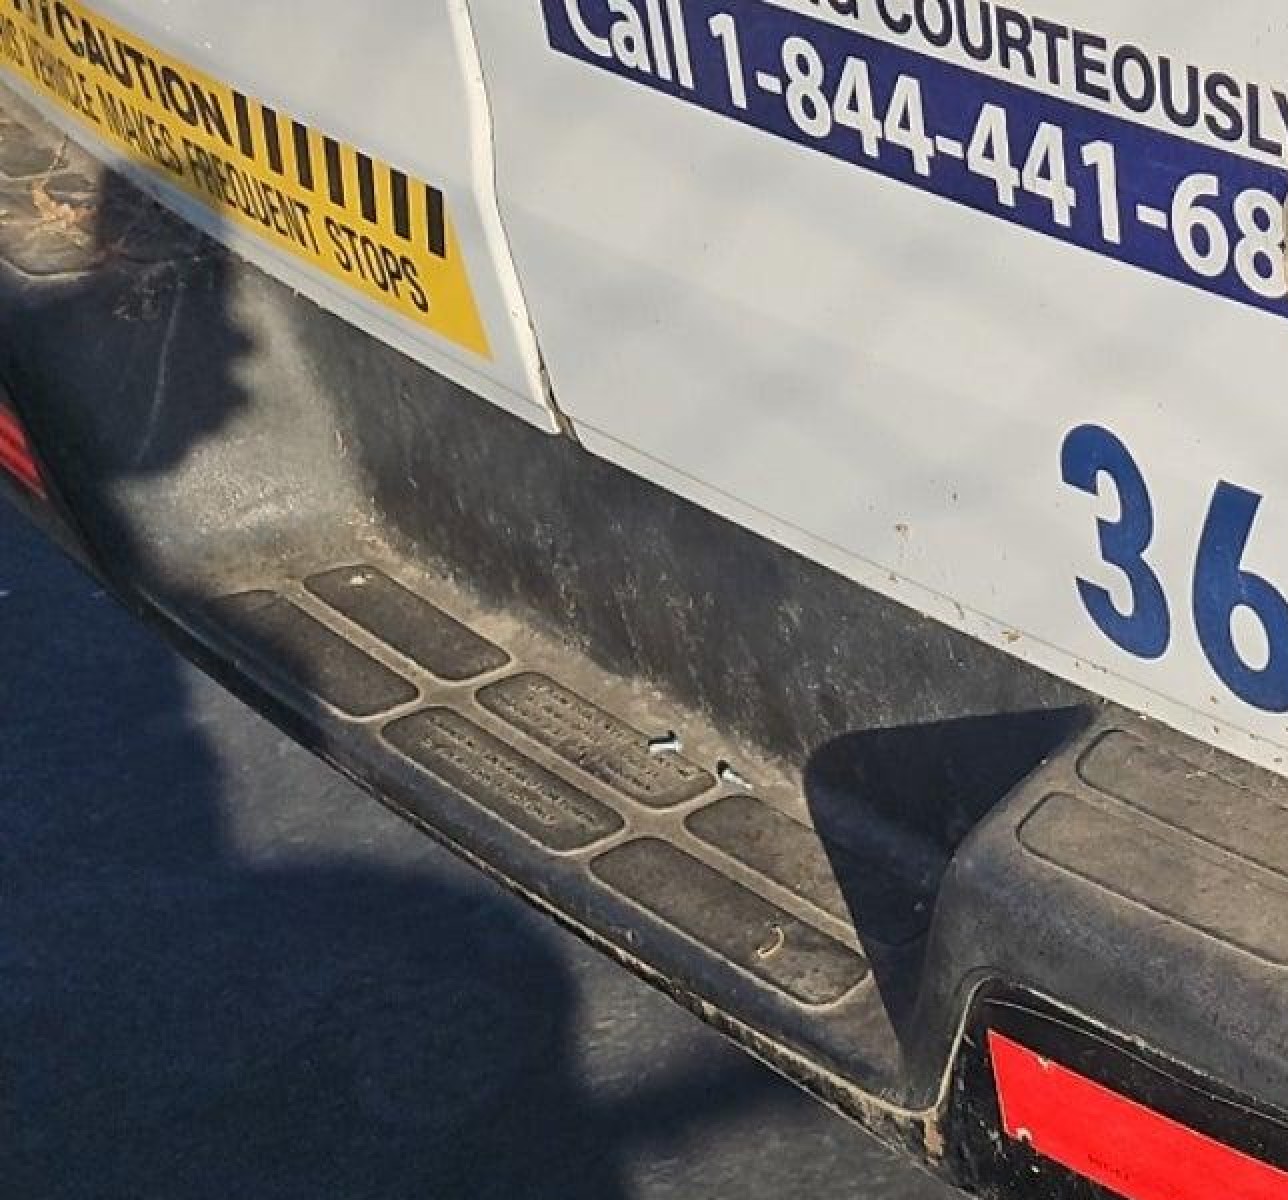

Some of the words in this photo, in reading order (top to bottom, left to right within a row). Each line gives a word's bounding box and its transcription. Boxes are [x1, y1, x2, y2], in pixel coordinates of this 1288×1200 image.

[53, 1, 235, 147] CAUTION
[563, 0, 695, 90] Call
[181, 138, 321, 256] FREQUENT
[323, 216, 429, 313] STOPS
